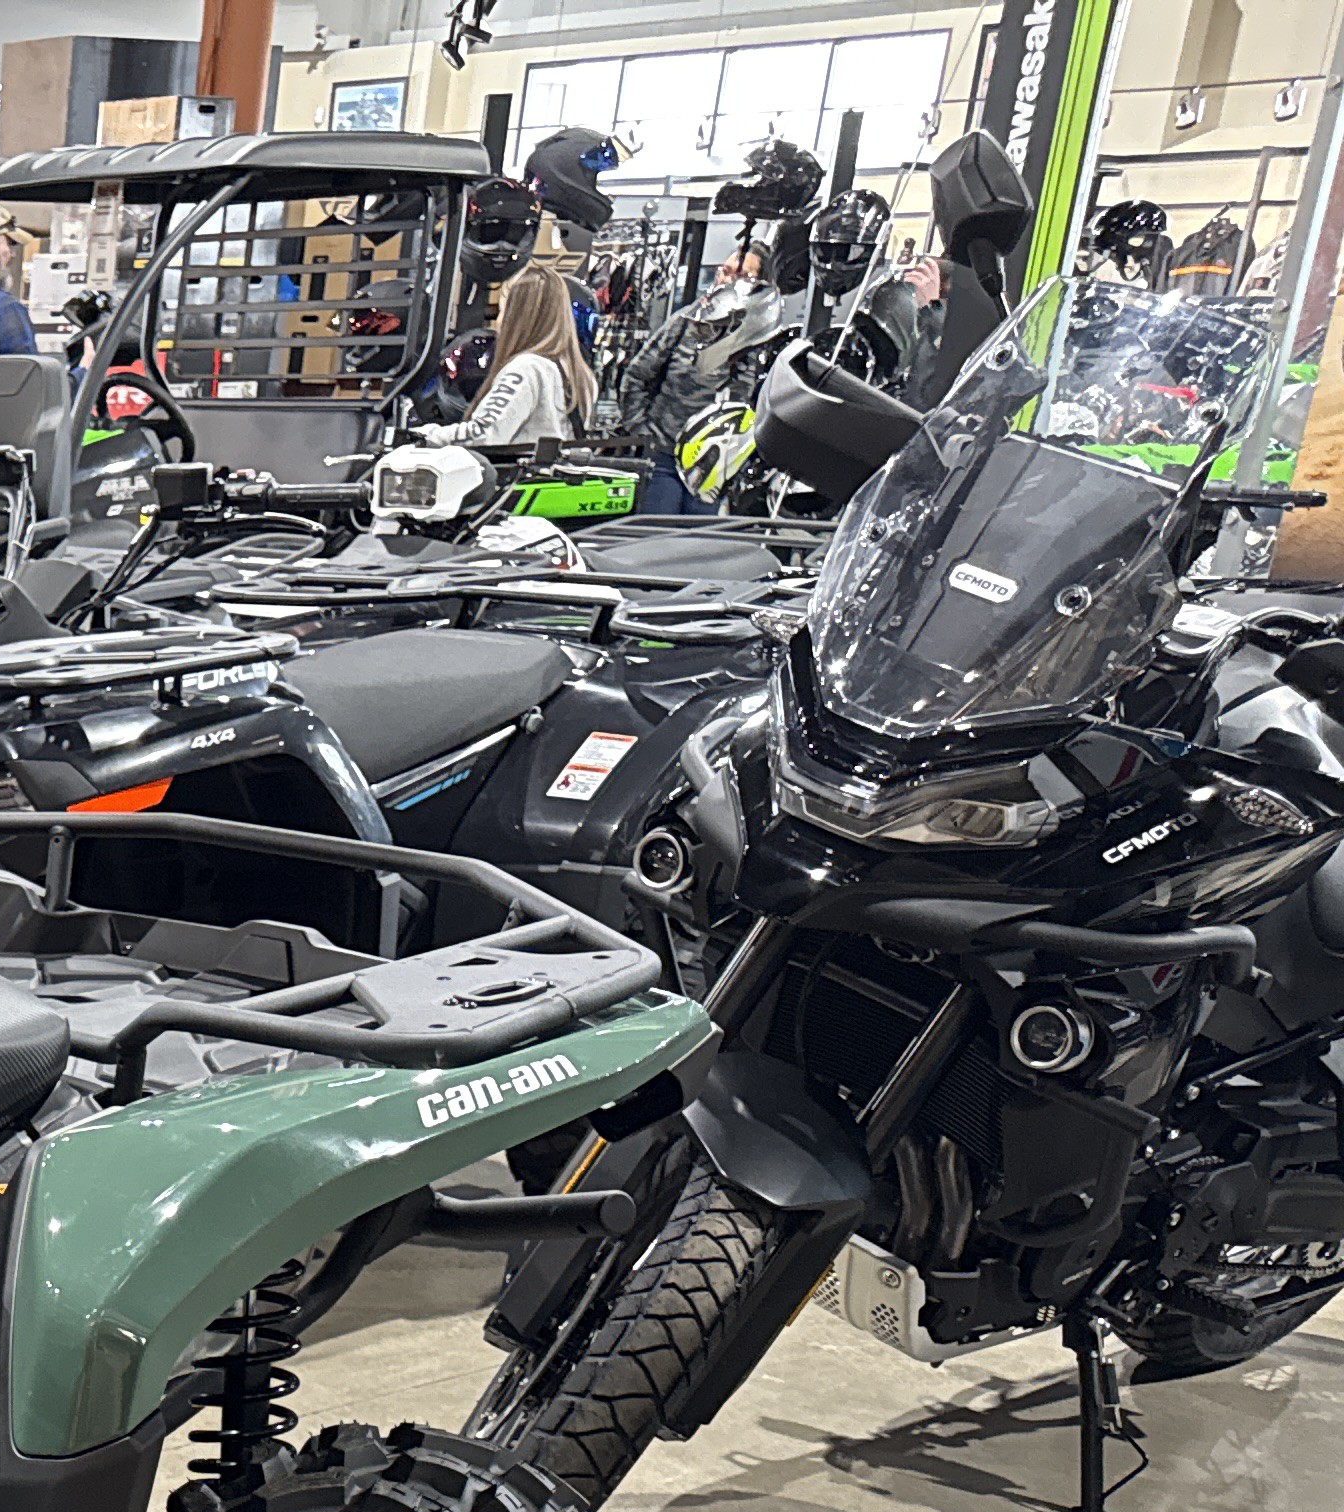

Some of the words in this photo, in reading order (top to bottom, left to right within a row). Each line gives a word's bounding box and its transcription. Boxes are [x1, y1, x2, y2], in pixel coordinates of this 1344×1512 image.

[1005, 0, 1055, 176] awasak
[955, 571, 1009, 596] CFMOTO
[1103, 813, 1199, 864] CFMOTO
[417, 1050, 580, 1129] can-am
